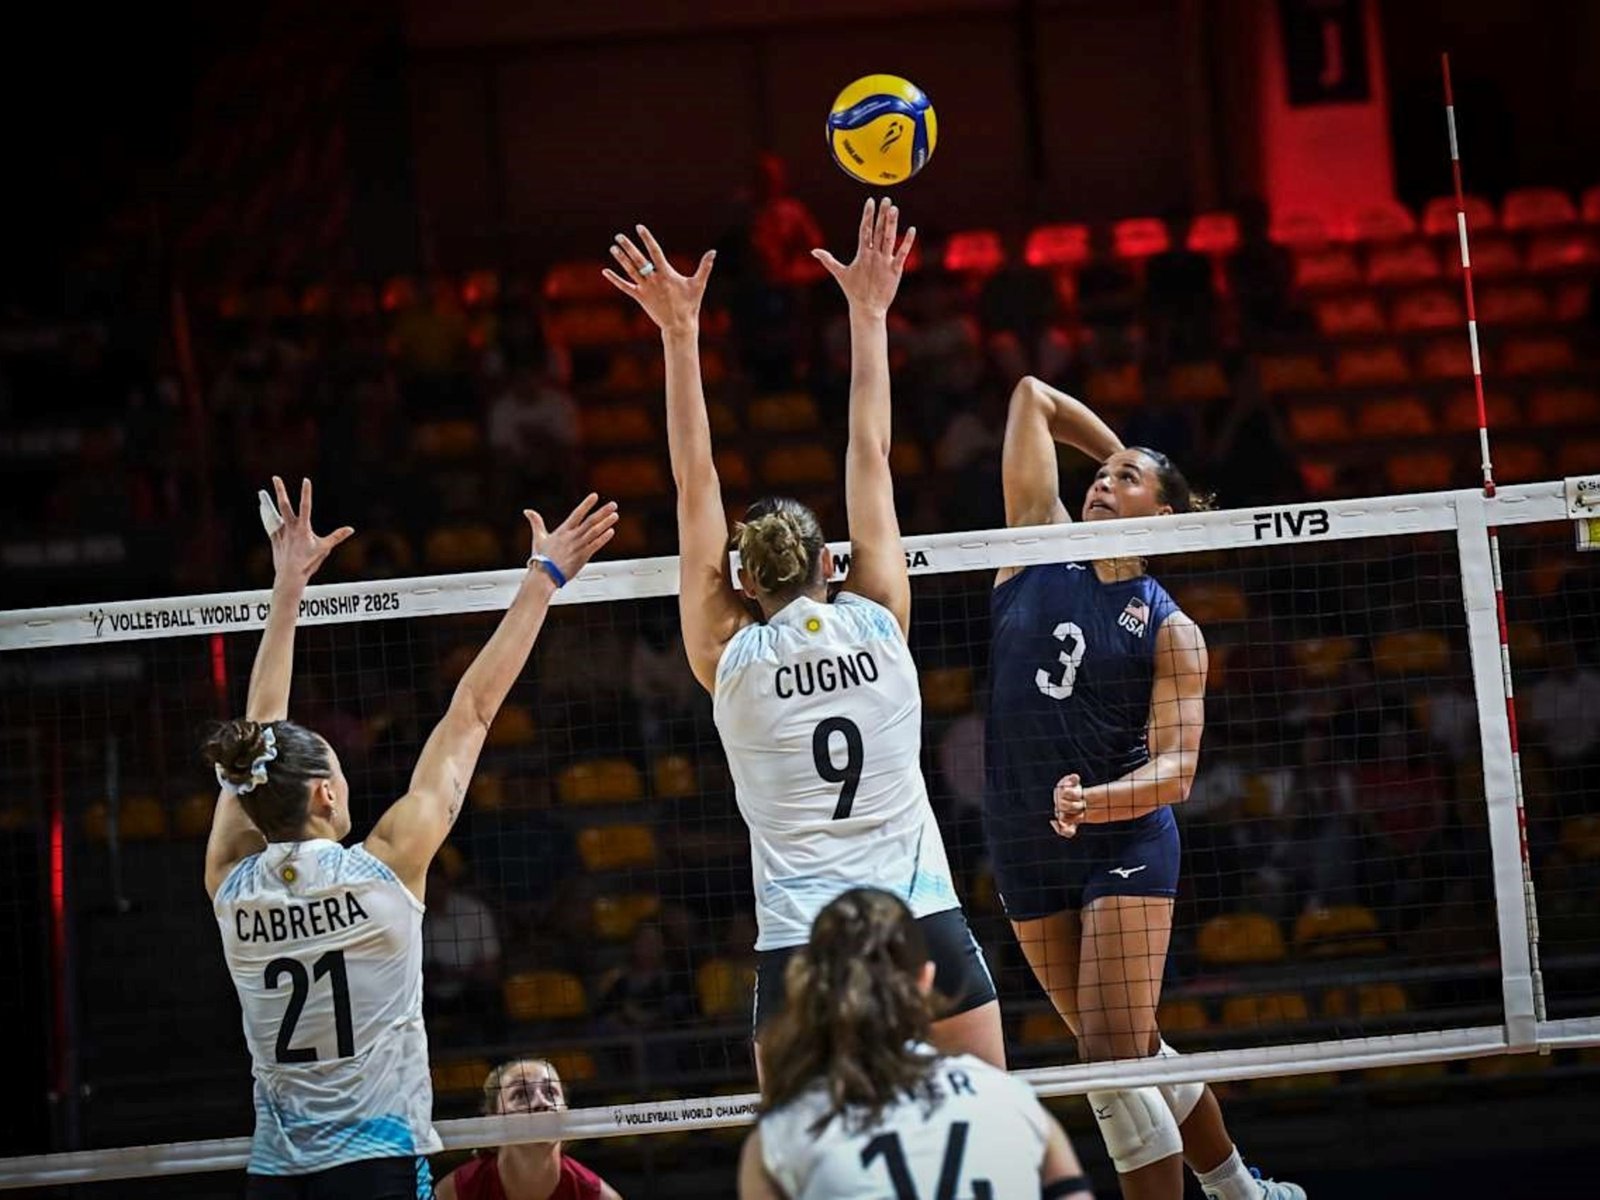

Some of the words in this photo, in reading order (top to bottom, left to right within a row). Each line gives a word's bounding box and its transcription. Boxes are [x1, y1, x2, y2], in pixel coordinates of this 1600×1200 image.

[1253, 509, 1330, 540] FIVB
[110, 607, 196, 632] VOLLEYBALL
[199, 604, 250, 626] WORLD
[256, 594, 360, 621] CPIONSHIP
[363, 592, 400, 612] 2025
[1117, 612, 1146, 638] USA
[775, 651, 879, 699] CUGNO
[1035, 622, 1087, 700] 3
[812, 716, 864, 821] 9
[235, 891, 369, 943] CABRERA
[263, 949, 355, 1063] 21
[625, 1112, 679, 1125] VOLLEYBALL
[681, 1107, 713, 1121] WORLD
